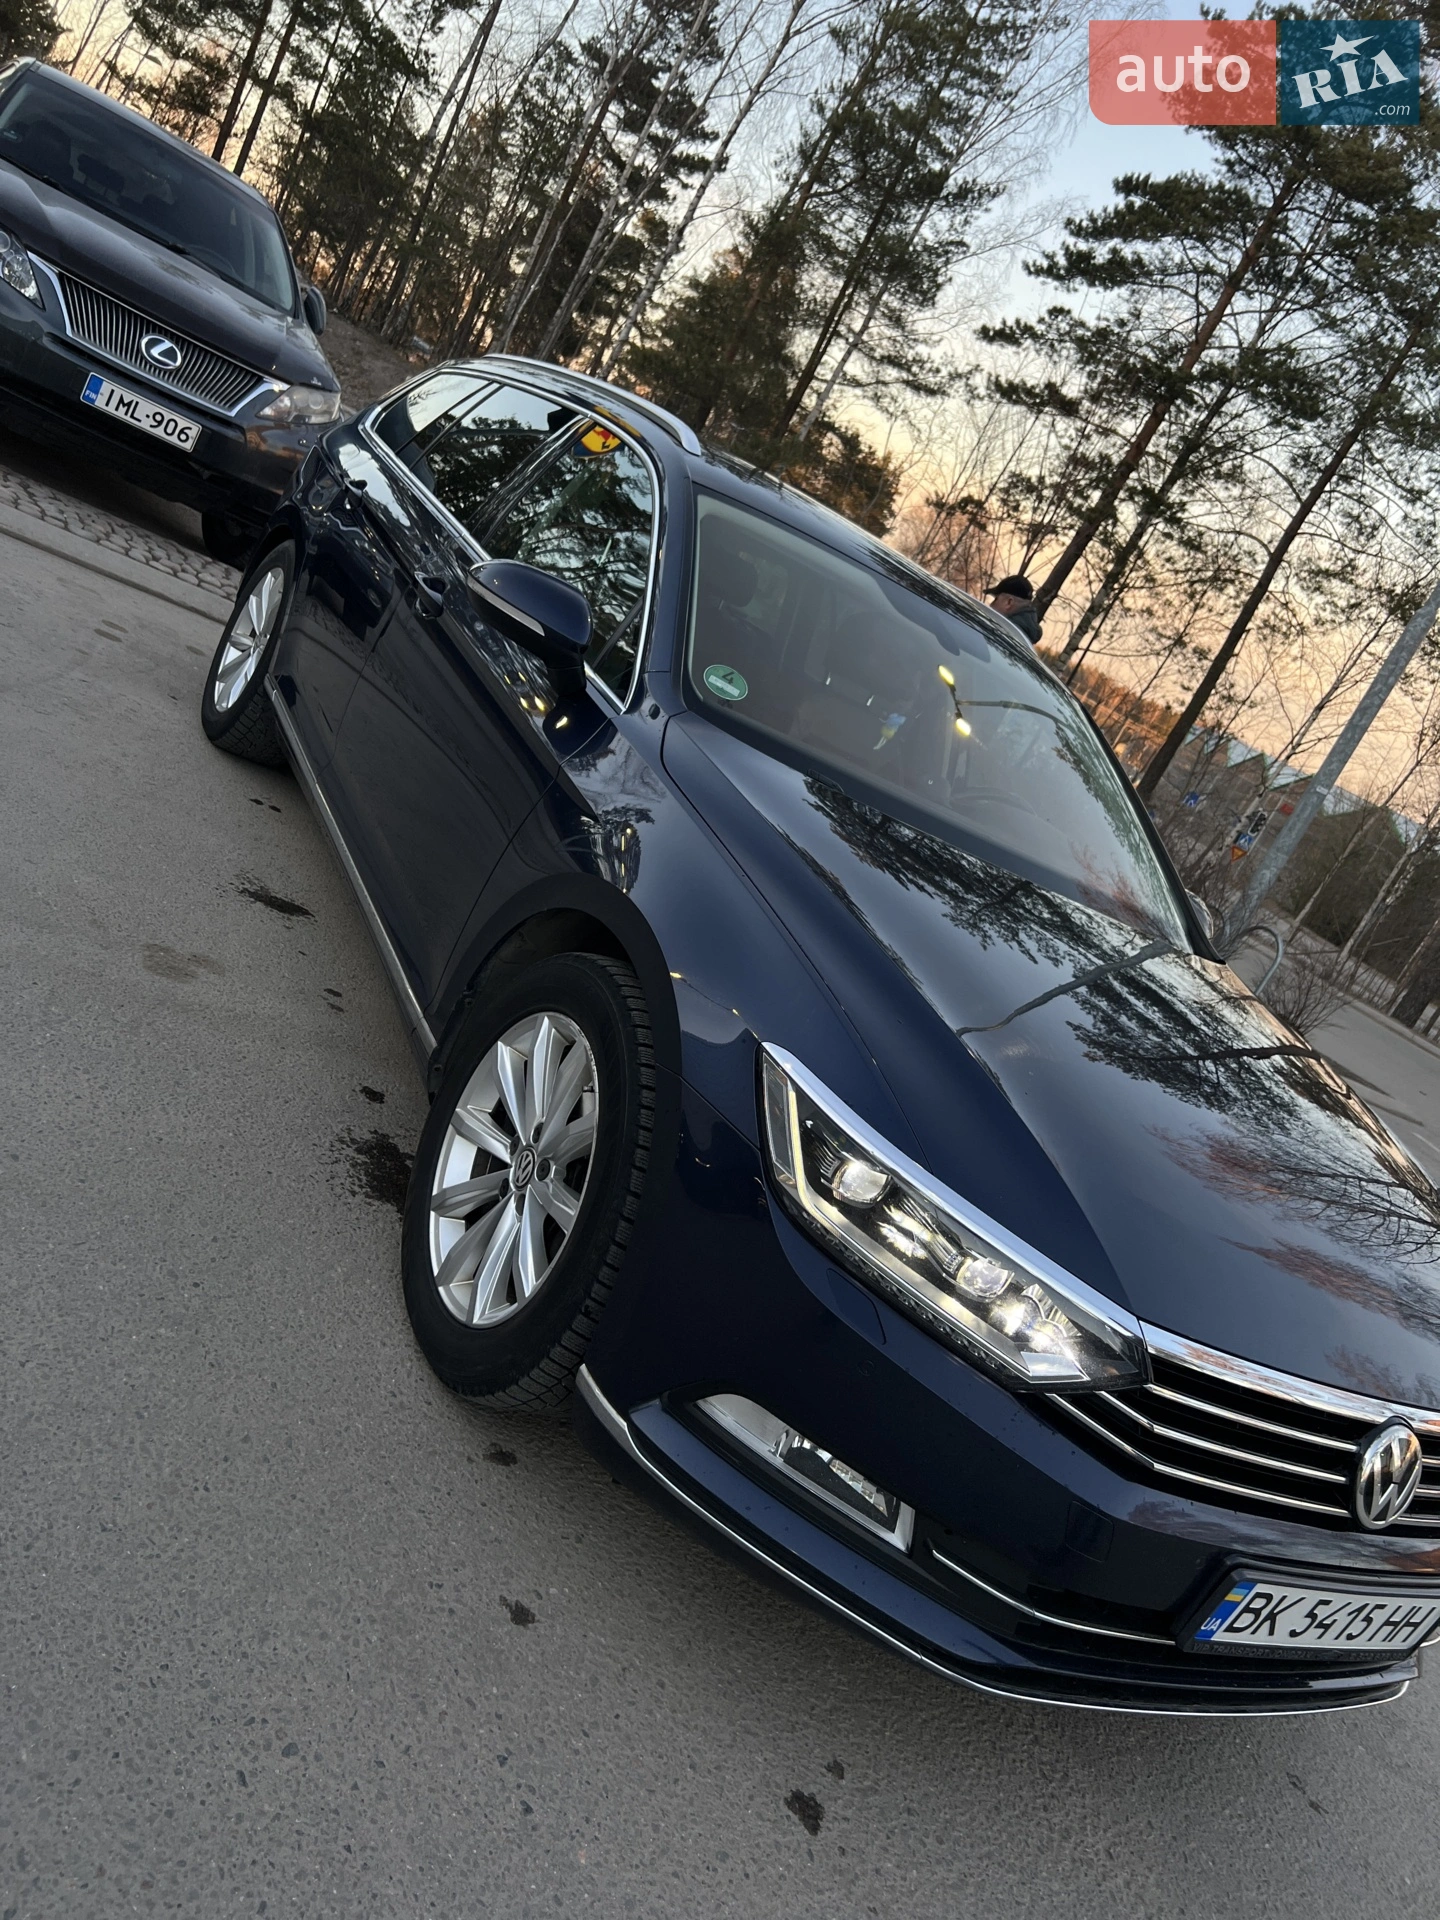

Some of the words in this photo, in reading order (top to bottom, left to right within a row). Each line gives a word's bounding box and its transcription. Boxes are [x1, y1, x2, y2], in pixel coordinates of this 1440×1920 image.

[84, 390, 98, 401] FIN
[1223, 1592, 1307, 1636] BK
[1201, 1616, 1222, 1632] UA
